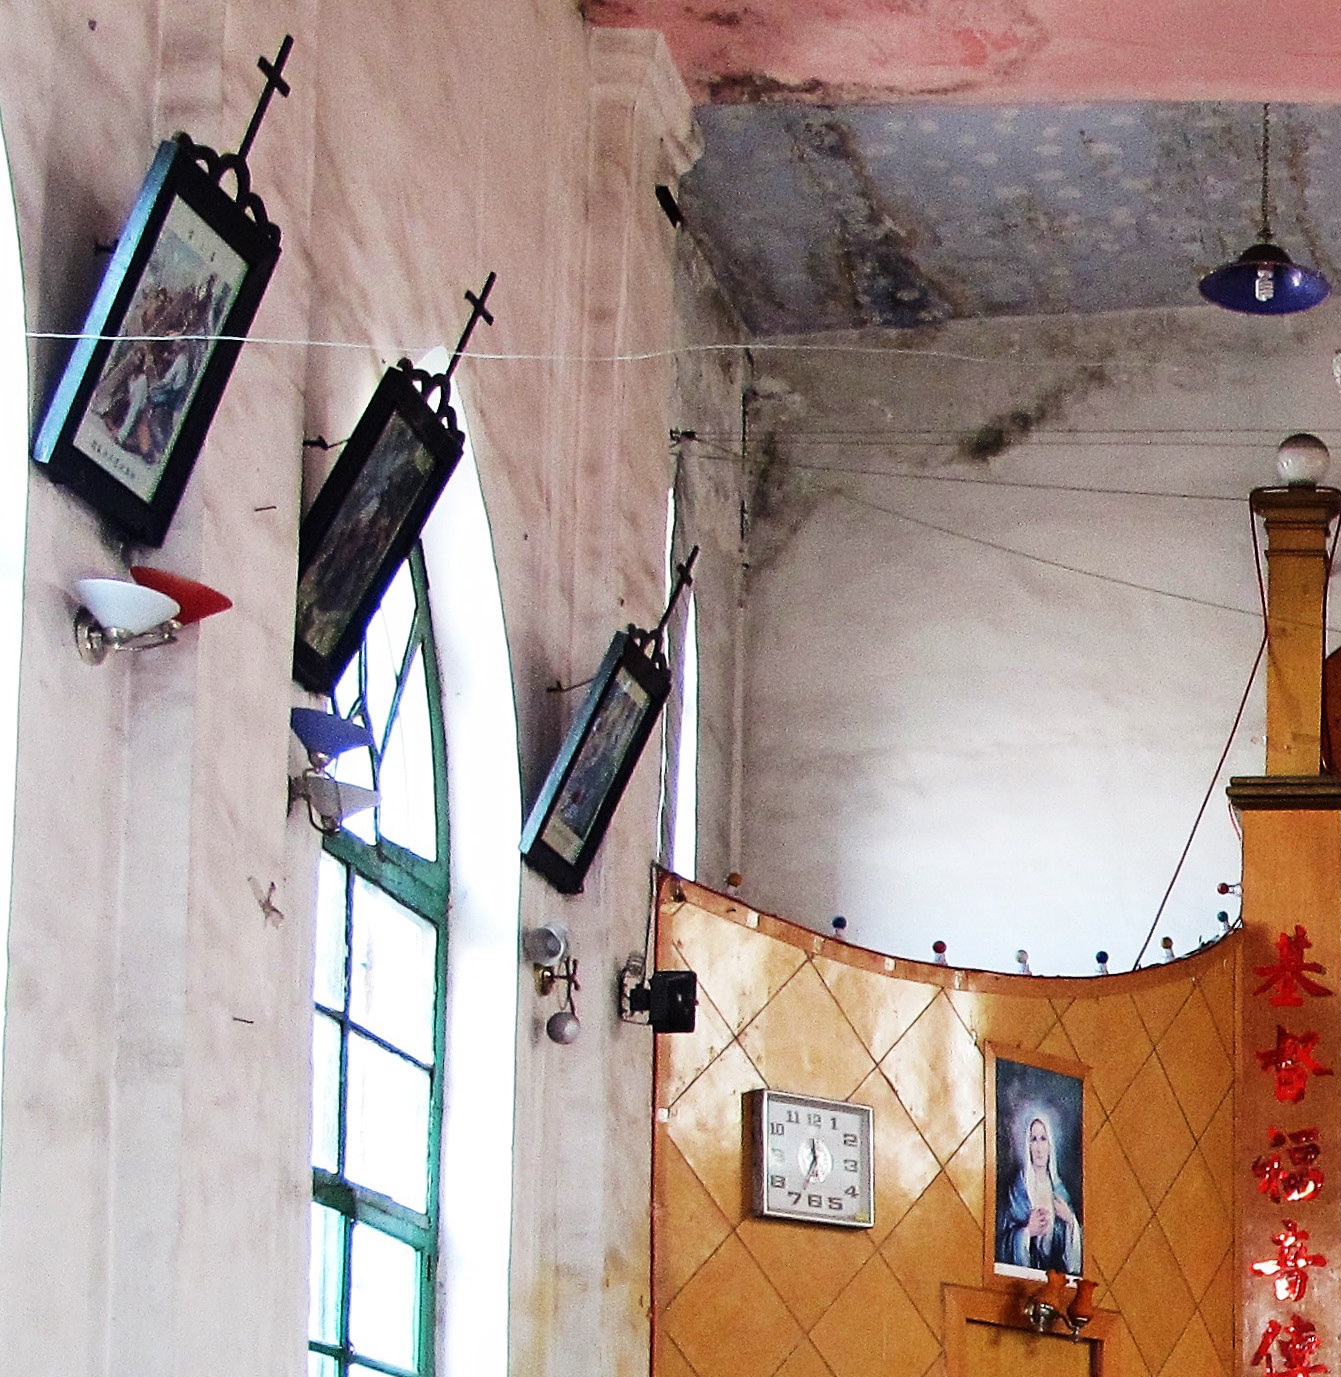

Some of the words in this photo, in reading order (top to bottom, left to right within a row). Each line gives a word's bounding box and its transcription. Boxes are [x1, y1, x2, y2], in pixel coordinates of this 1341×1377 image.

[786, 1111, 800, 1124] 11
[830, 1117, 838, 1130] 1
[770, 1122, 785, 1135] 10
[843, 1133, 859, 1147] 2
[844, 1159, 858, 1173] 3
[771, 1175, 785, 1189] 8
[787, 1192, 802, 1205] 7
[844, 1185, 859, 1199] 4
[828, 1197, 843, 1211] 5
